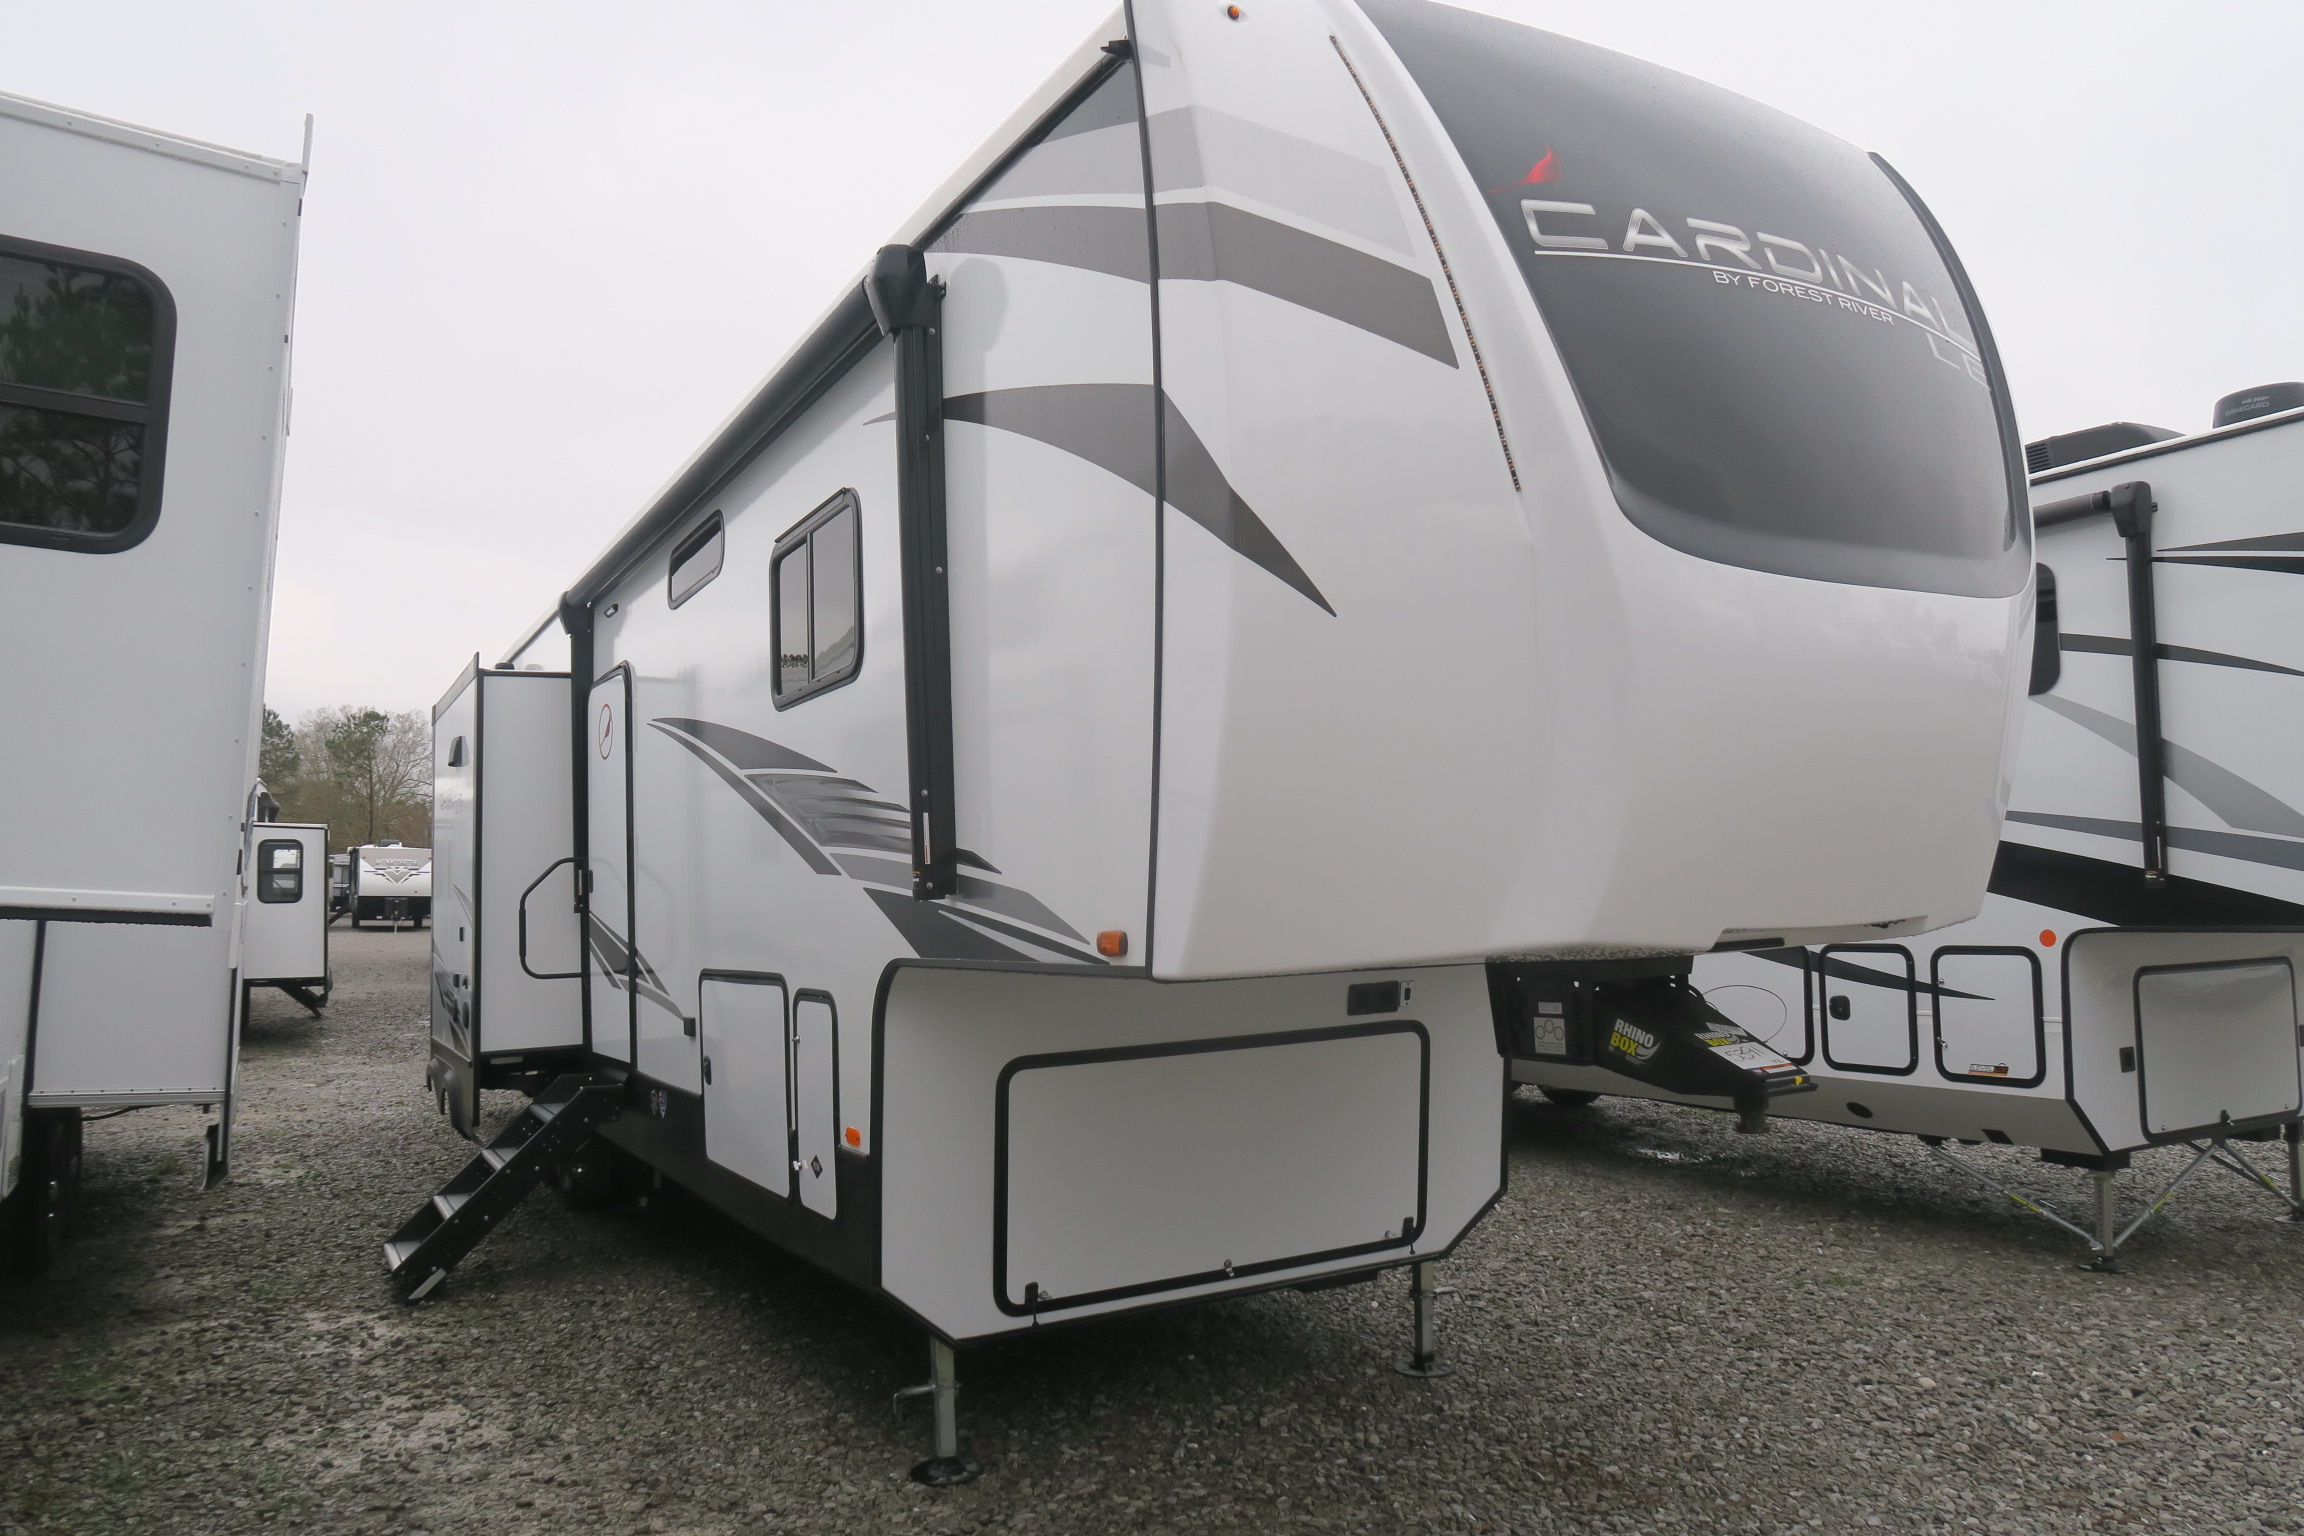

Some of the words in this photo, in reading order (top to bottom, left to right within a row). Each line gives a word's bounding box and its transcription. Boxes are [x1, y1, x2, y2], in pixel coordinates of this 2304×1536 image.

[1521, 198, 1980, 353] CARDINAL
[1712, 270, 1740, 286] BY
[1747, 276, 1833, 305] FOREST
[1837, 296, 1895, 326] RIVER
[2225, 401, 2270, 416] WINEGARD
[1610, 1031, 1640, 1057] BOX
[1614, 1018, 1654, 1048] RHINO
